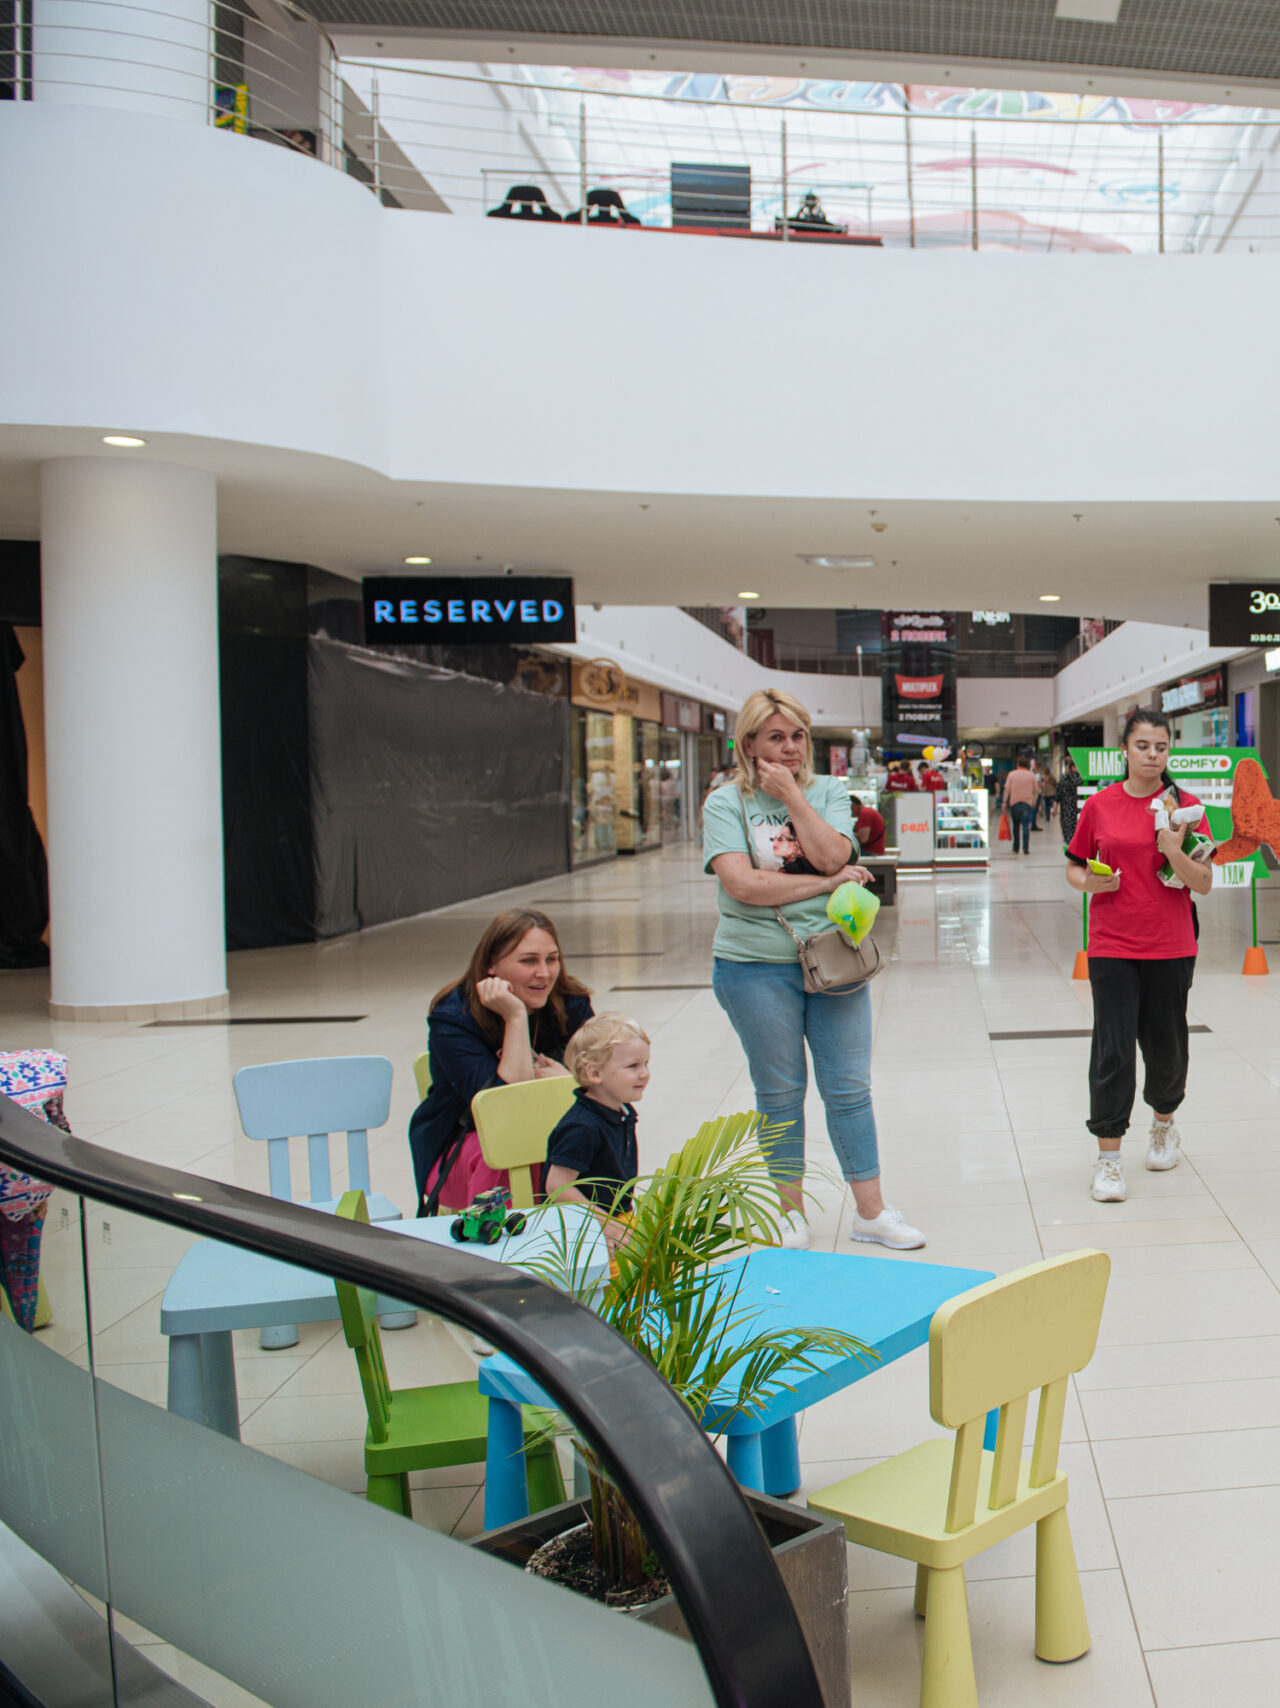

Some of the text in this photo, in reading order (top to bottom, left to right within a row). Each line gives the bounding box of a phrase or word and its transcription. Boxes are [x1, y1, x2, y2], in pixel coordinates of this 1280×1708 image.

[374, 600, 564, 623] RESERVED
[902, 682, 938, 692] MULTIPLEX
[905, 713, 942, 721] ПОВЕРХ
[1170, 758, 1218, 769] COMFY
[1222, 864, 1245, 885] ТУДИ
